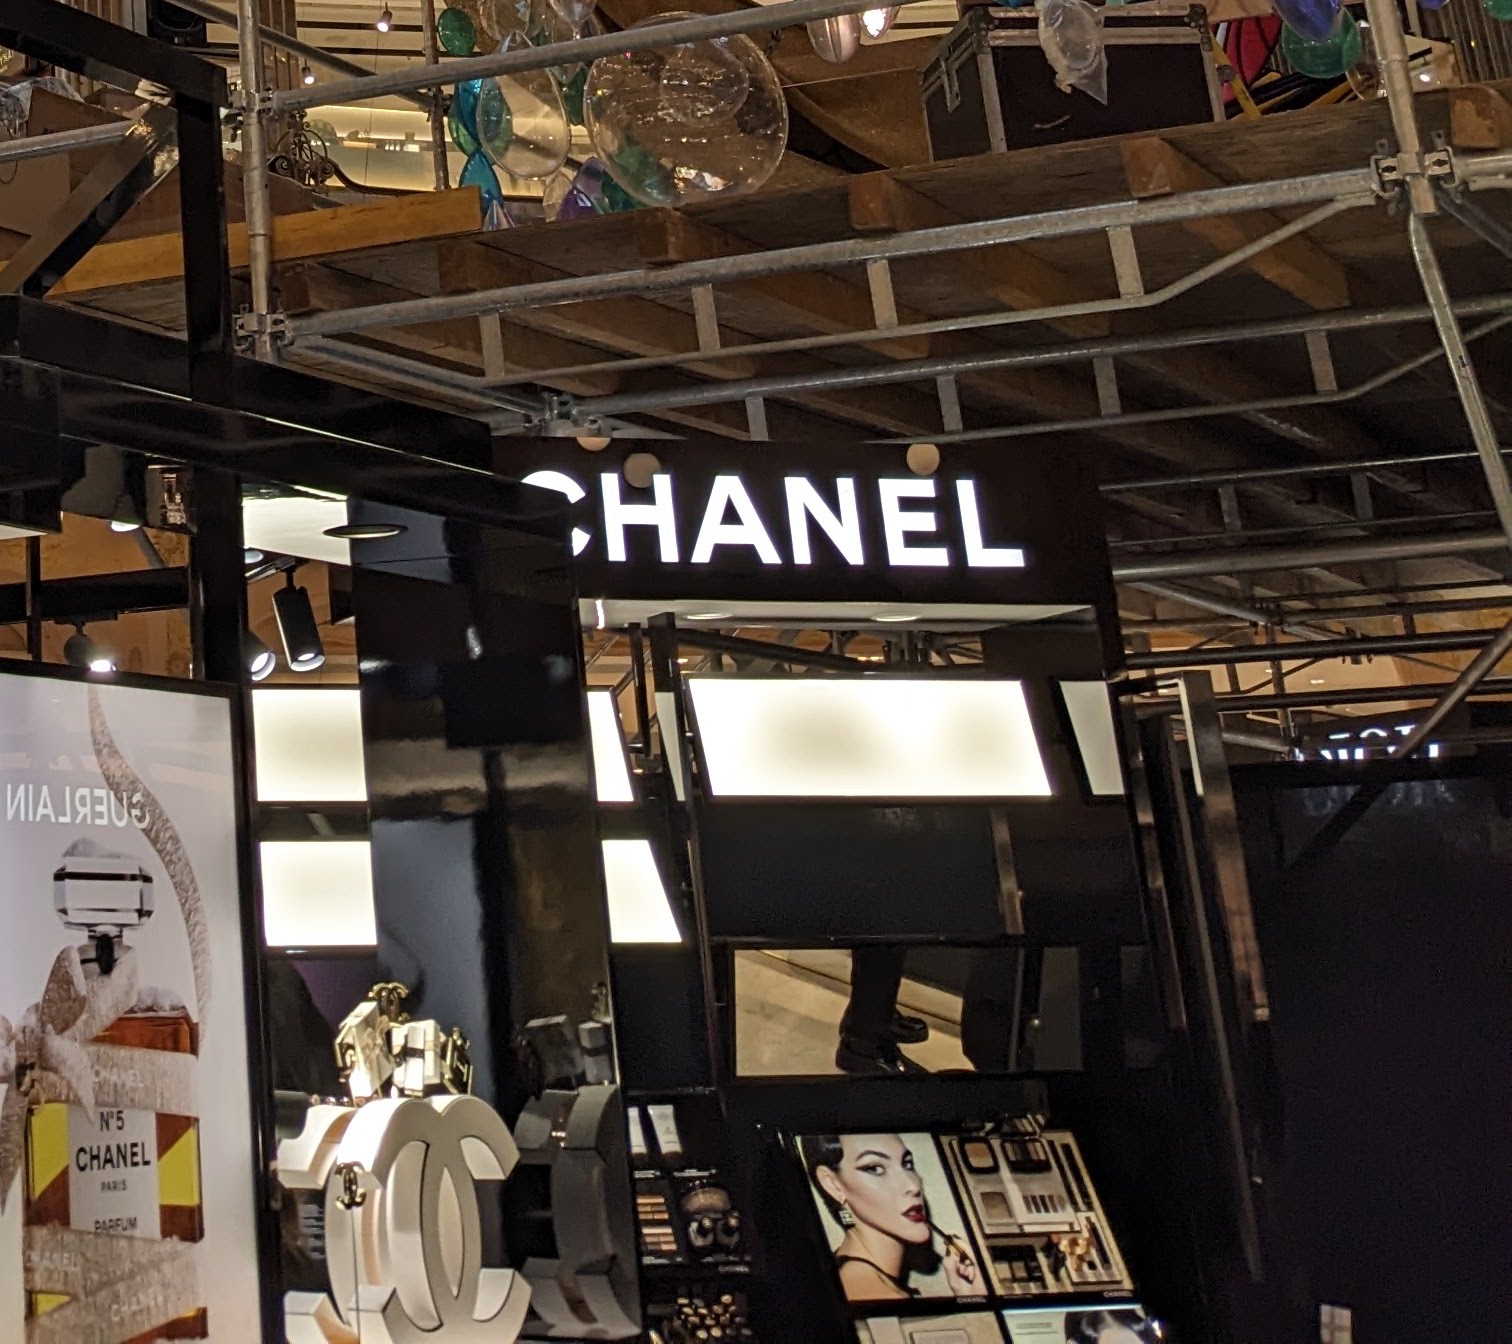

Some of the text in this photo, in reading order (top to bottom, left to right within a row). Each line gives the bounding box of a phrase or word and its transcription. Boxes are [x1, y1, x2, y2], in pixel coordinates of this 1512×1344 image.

[75, 1141, 152, 1172] CHANEL
[100, 1179, 128, 1192] PARIS
[93, 1216, 138, 1233] PARFUM
